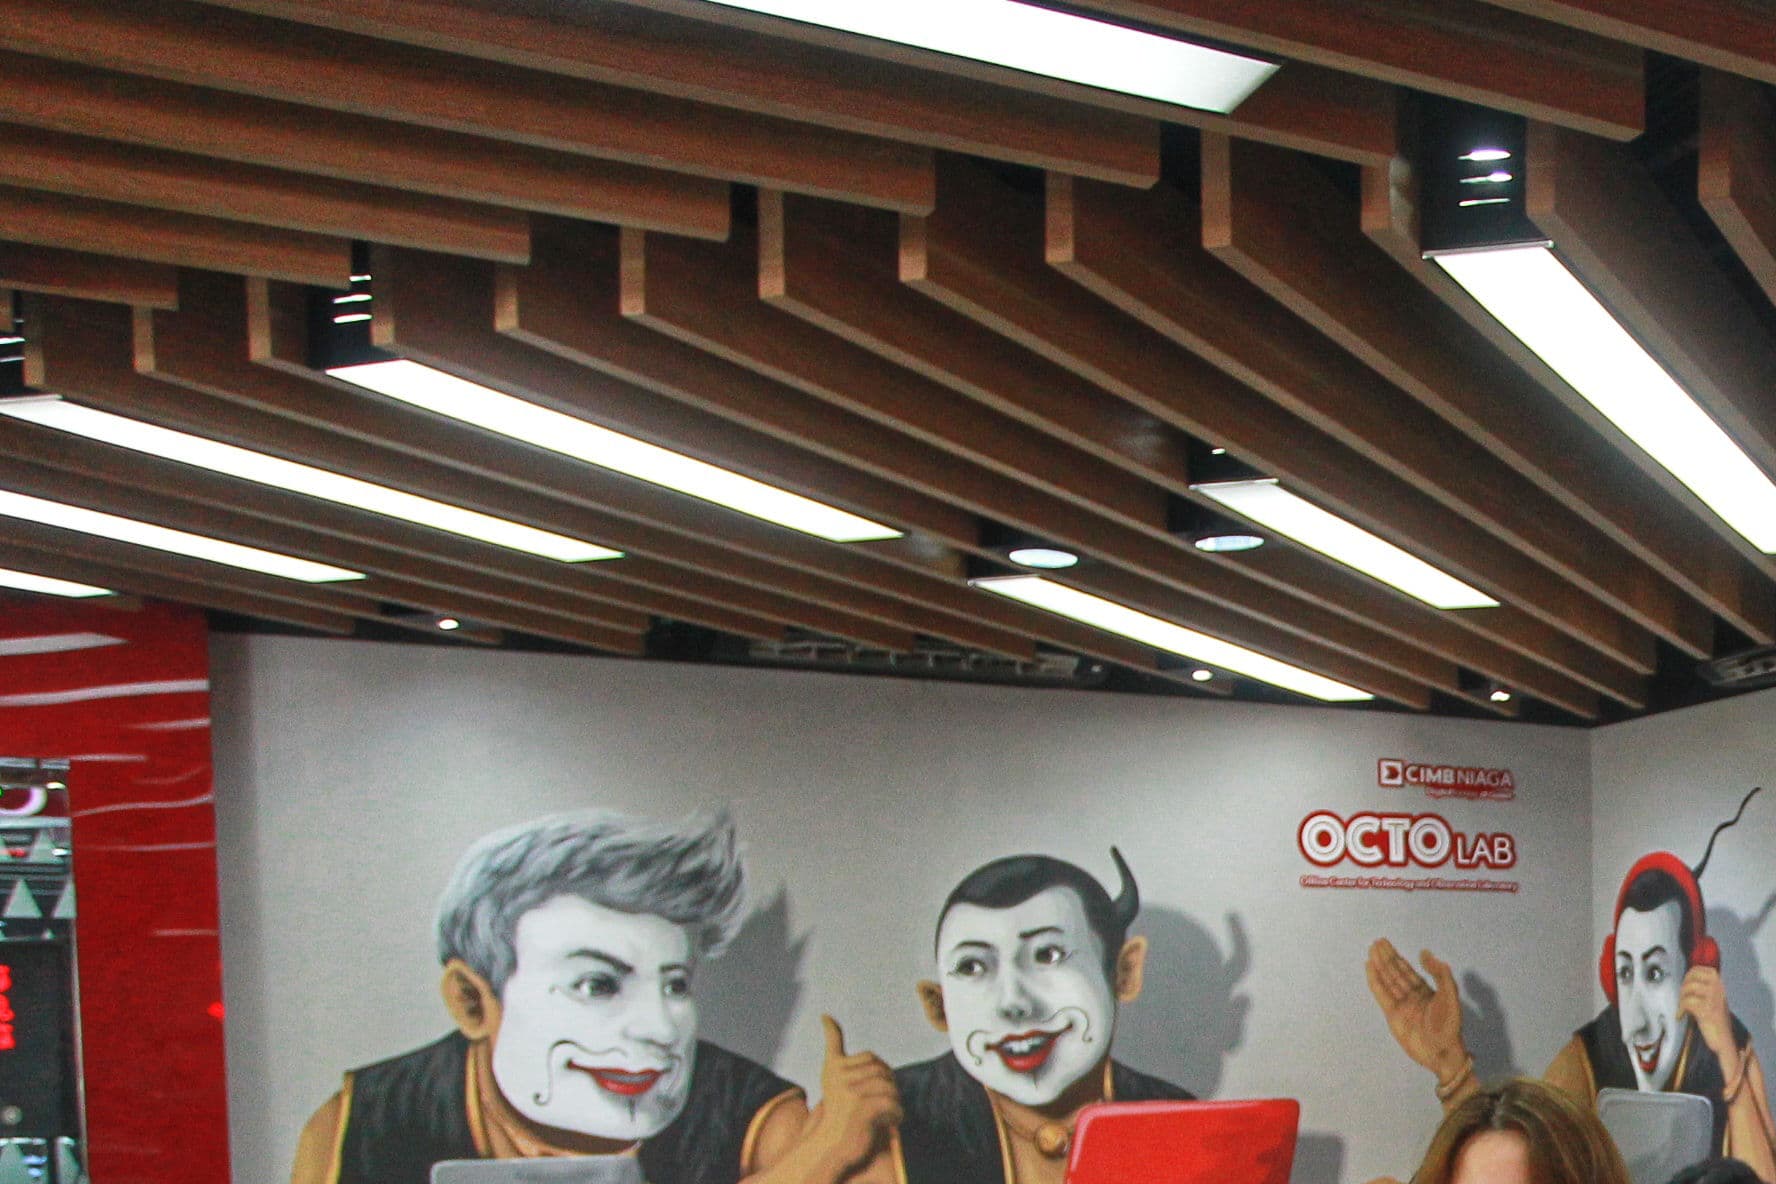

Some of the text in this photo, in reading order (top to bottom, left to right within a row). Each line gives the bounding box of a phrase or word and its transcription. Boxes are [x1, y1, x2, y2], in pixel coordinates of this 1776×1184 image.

[1405, 766, 1512, 787] CIMB NIAGA
[1301, 814, 1513, 864] OCTO LAB
